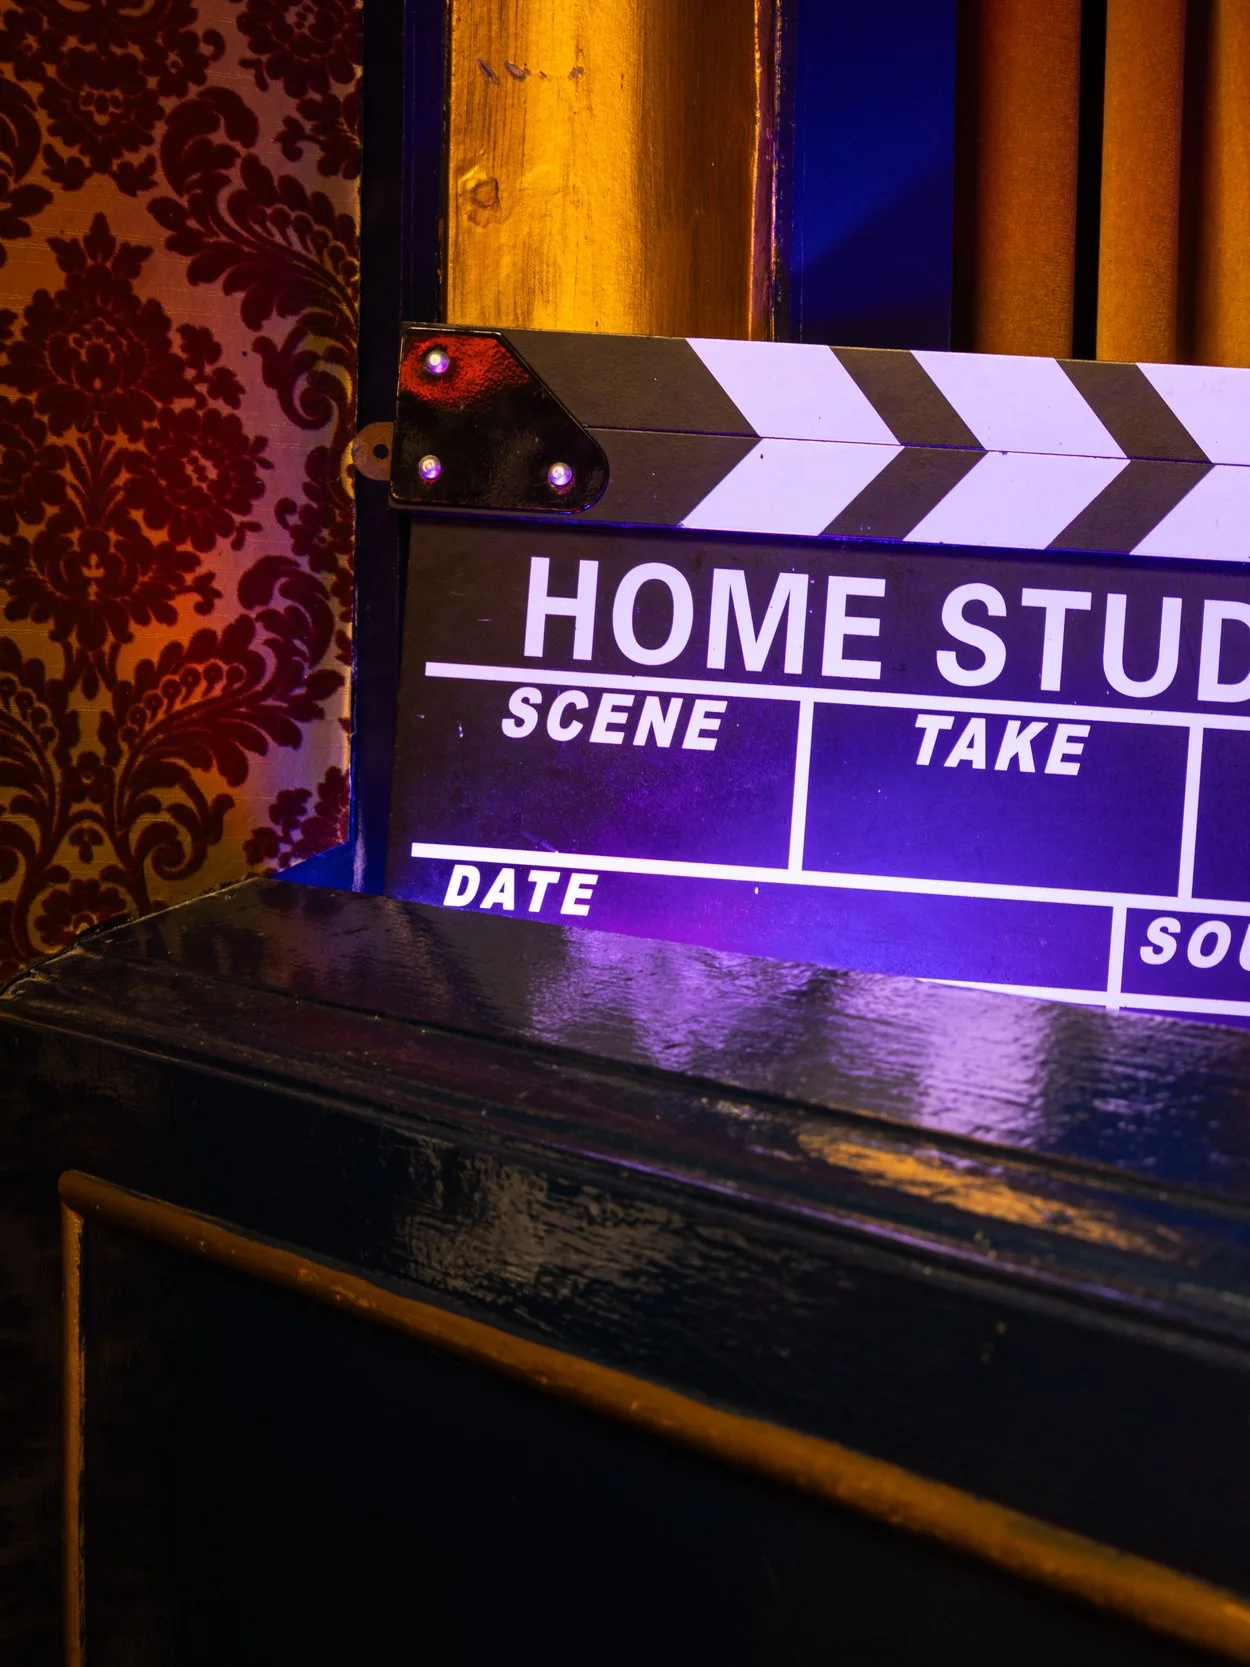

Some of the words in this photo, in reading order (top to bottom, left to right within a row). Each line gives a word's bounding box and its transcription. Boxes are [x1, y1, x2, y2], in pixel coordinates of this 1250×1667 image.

[523, 556, 886, 680] HOME
[501, 686, 728, 752] SCENE
[914, 713, 1091, 776] TAKE
[442, 864, 599, 917] DATE
